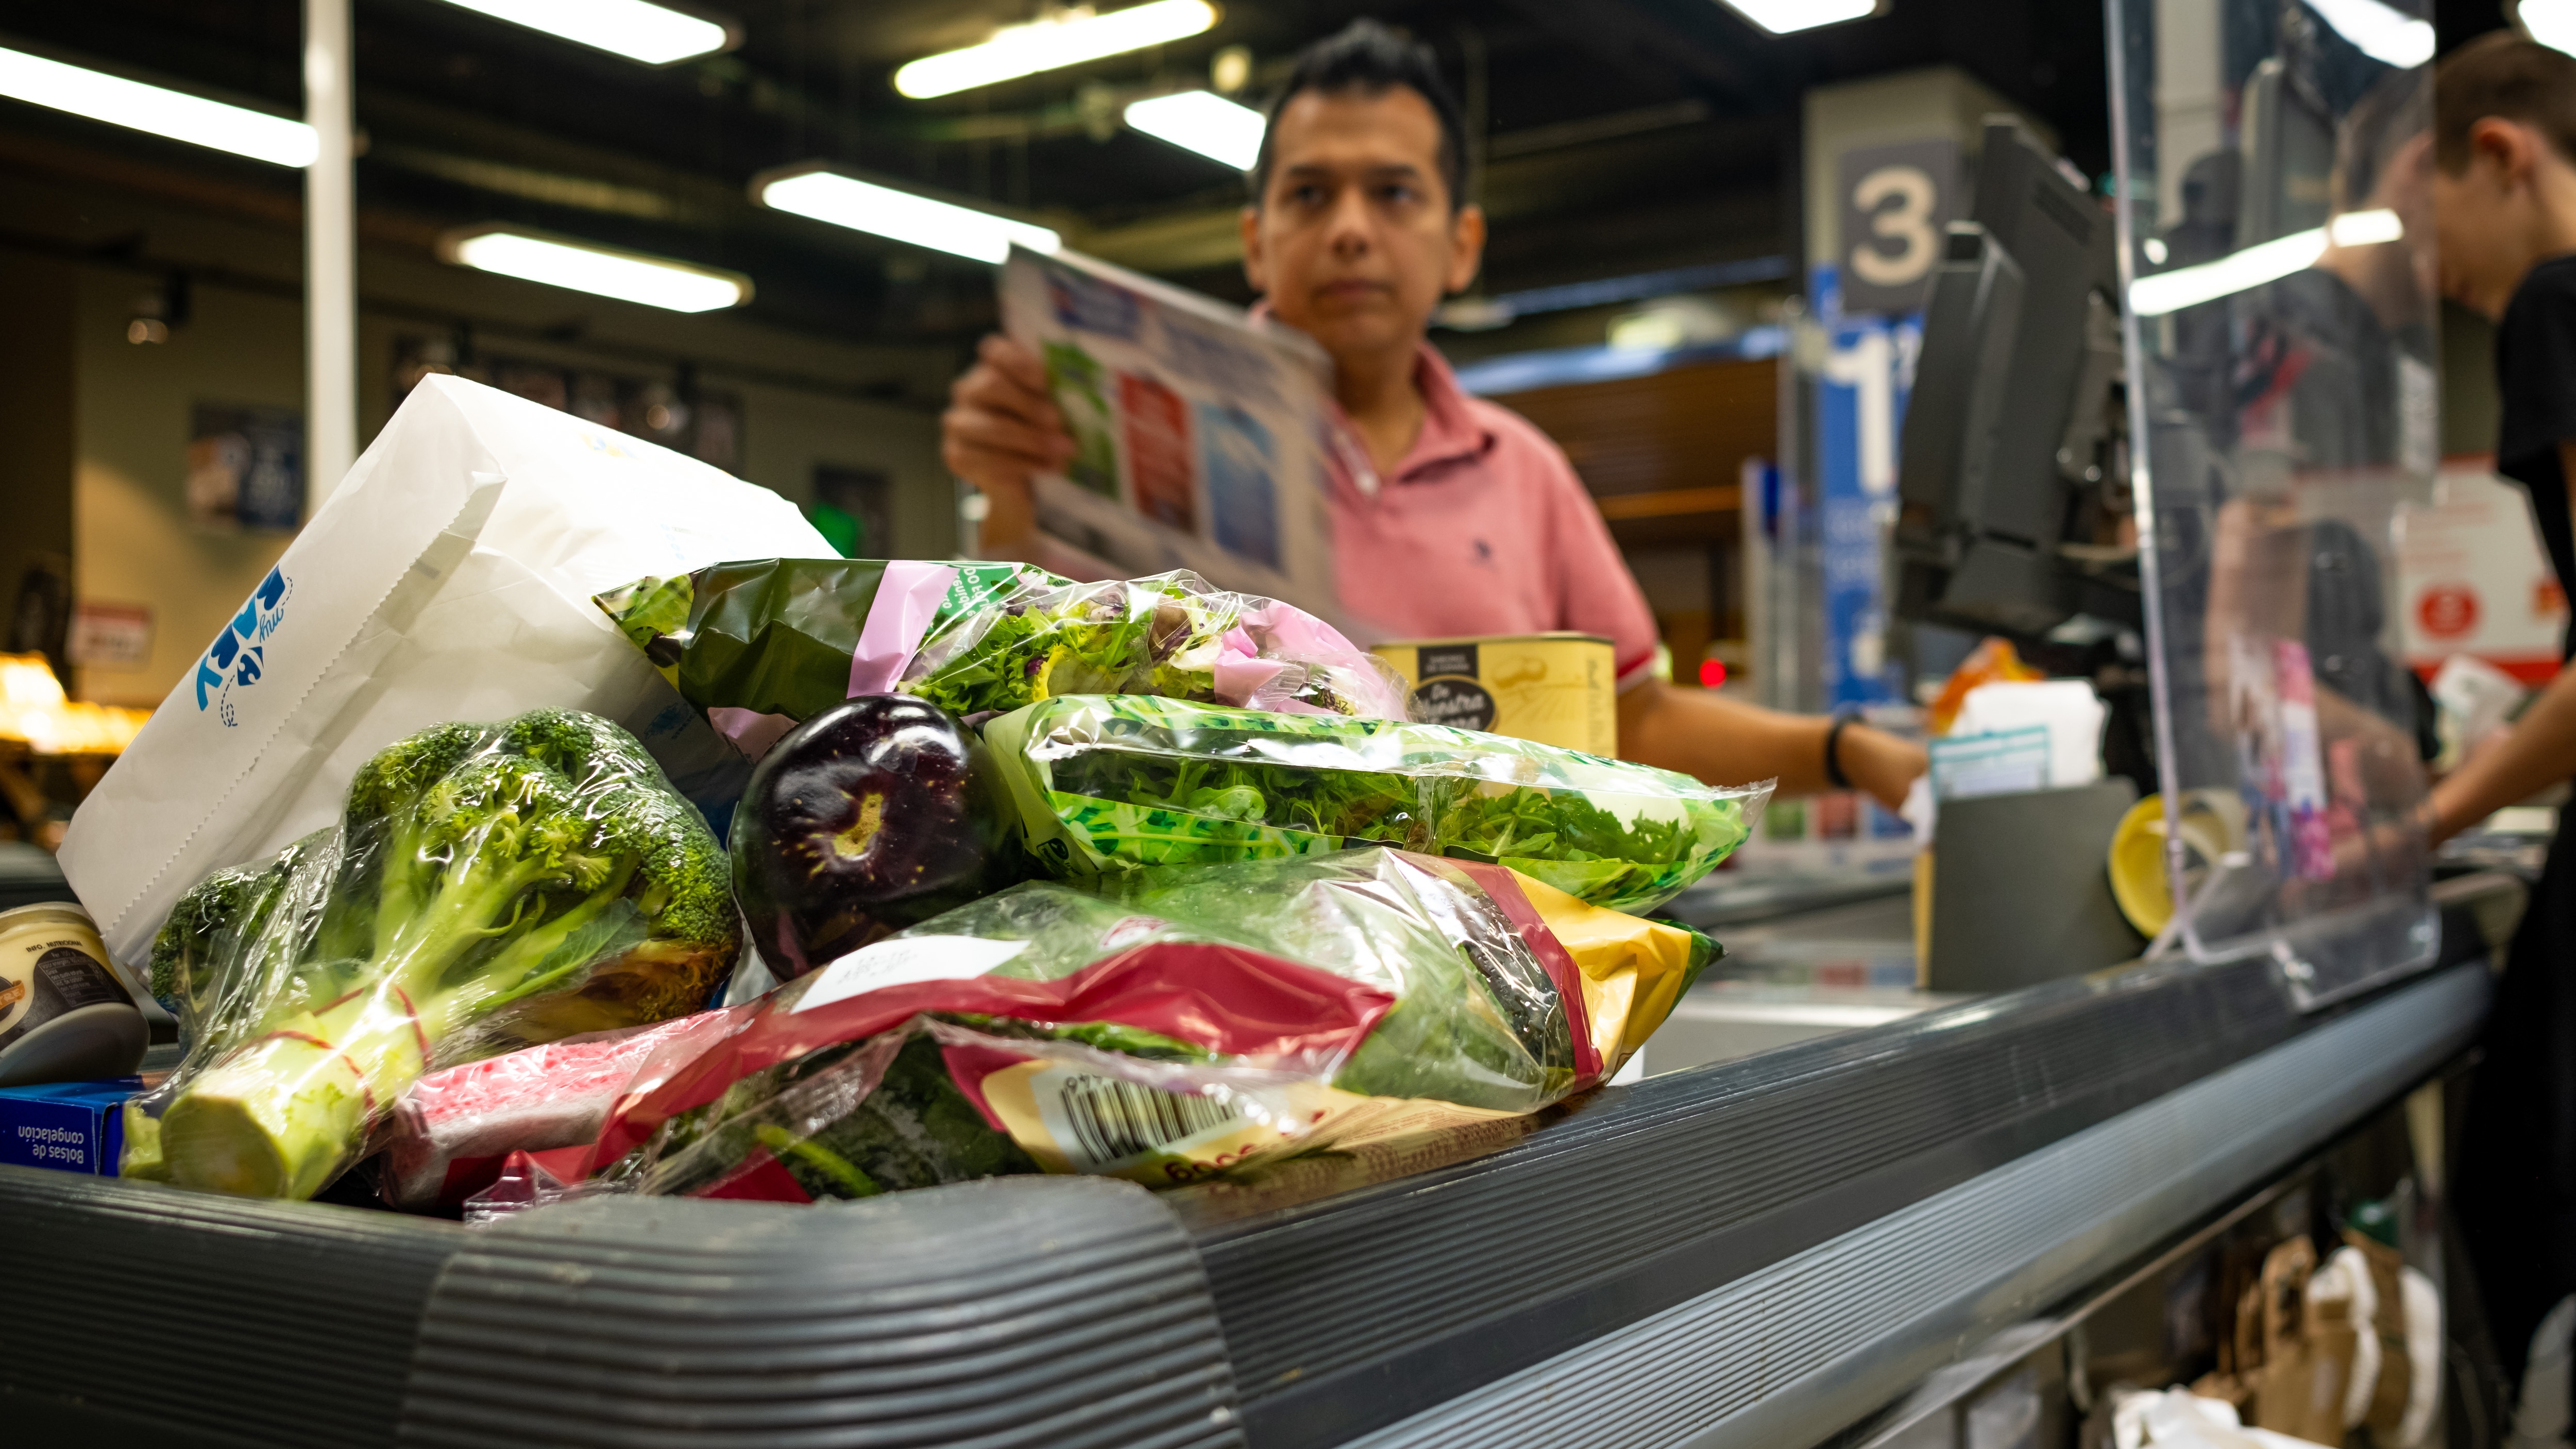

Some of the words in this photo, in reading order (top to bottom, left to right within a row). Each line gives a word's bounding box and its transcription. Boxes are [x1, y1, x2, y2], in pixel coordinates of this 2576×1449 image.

[1852, 166, 1939, 286] 3
[196, 563, 285, 712] BABY
[18, 1126, 84, 1145] congelación
[32, 1144, 46, 1160] de
[48, 1146, 84, 1164] Bolsas
